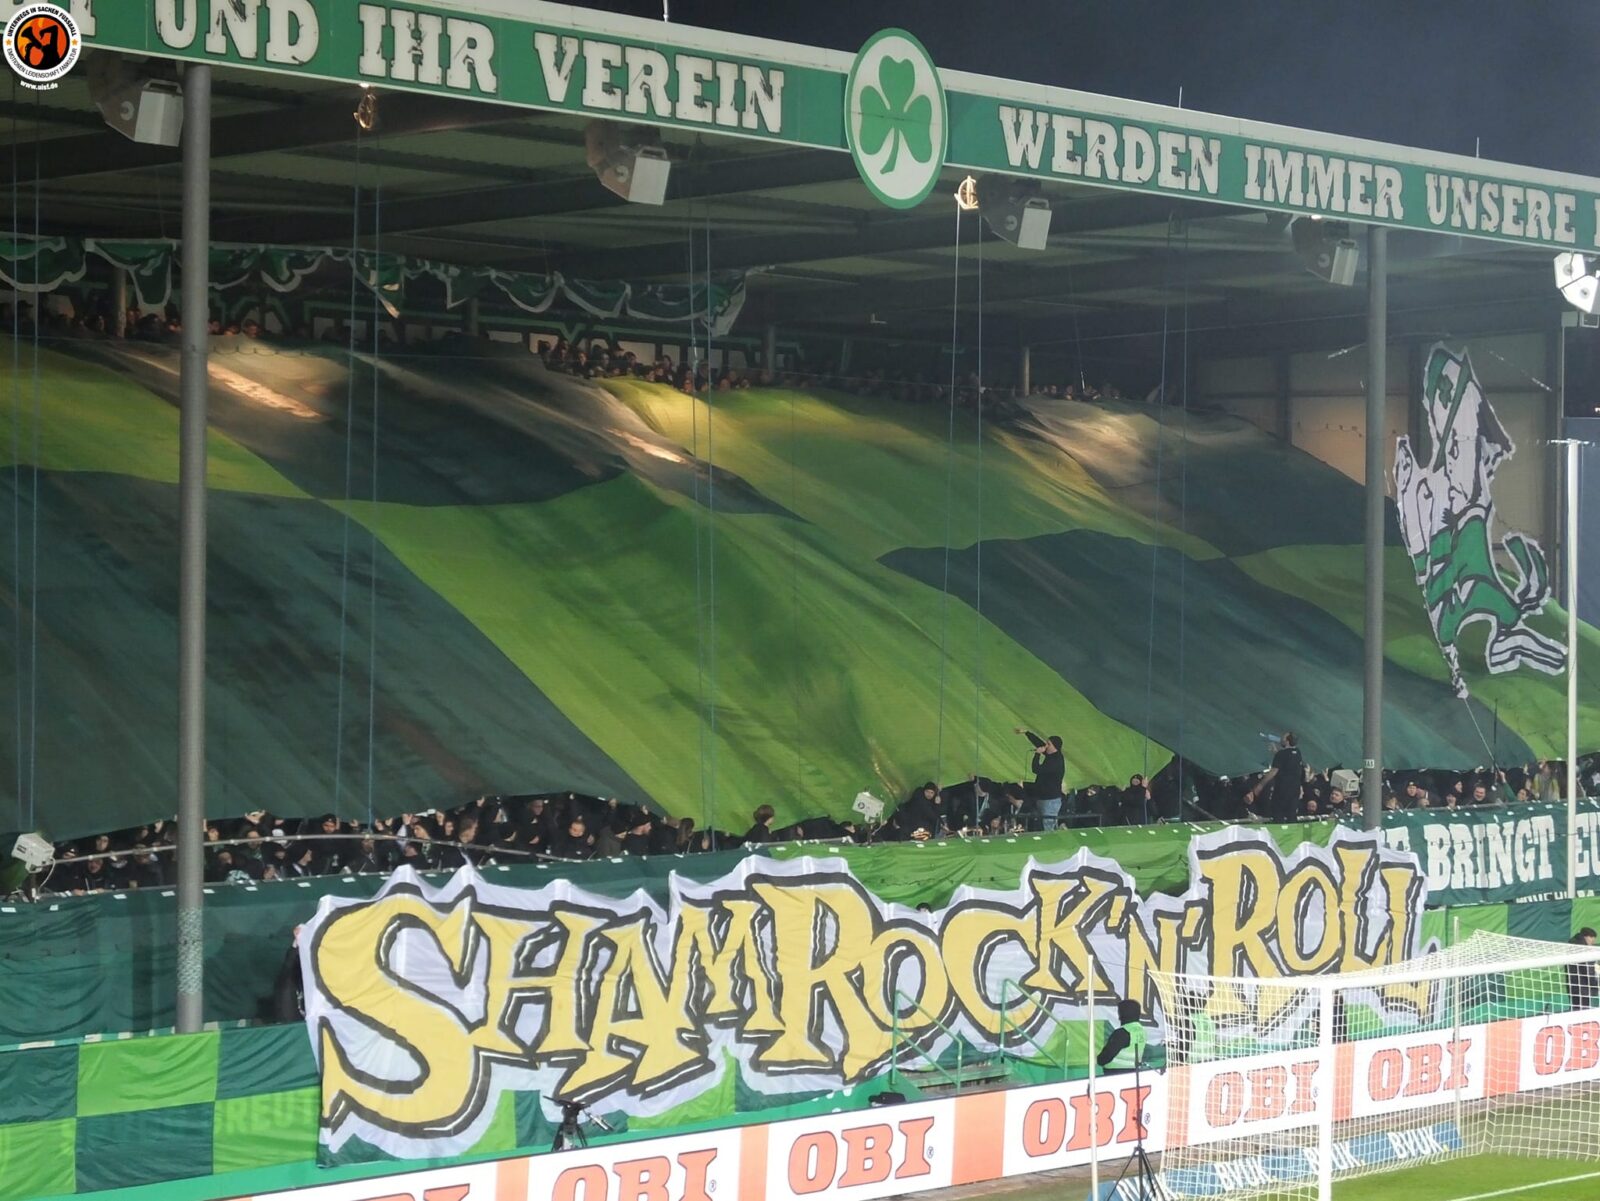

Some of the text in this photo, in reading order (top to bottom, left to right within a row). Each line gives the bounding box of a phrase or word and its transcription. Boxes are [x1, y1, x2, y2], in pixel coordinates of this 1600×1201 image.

[155, 0, 319, 65] UND
[358, 4, 498, 94] IHR
[534, 32, 785, 133] VEREIN
[1000, 106, 1221, 194] WERDEN
[1244, 144, 1403, 219] IMMER
[1426, 174, 1576, 244] UNSERE
[1423, 815, 1555, 891] BRINGT
[1205, 1060, 1320, 1128] OBI
[1368, 1038, 1471, 1101] OBI
[788, 1116, 934, 1195] OBI
[1022, 1085, 1151, 1157] OBI
